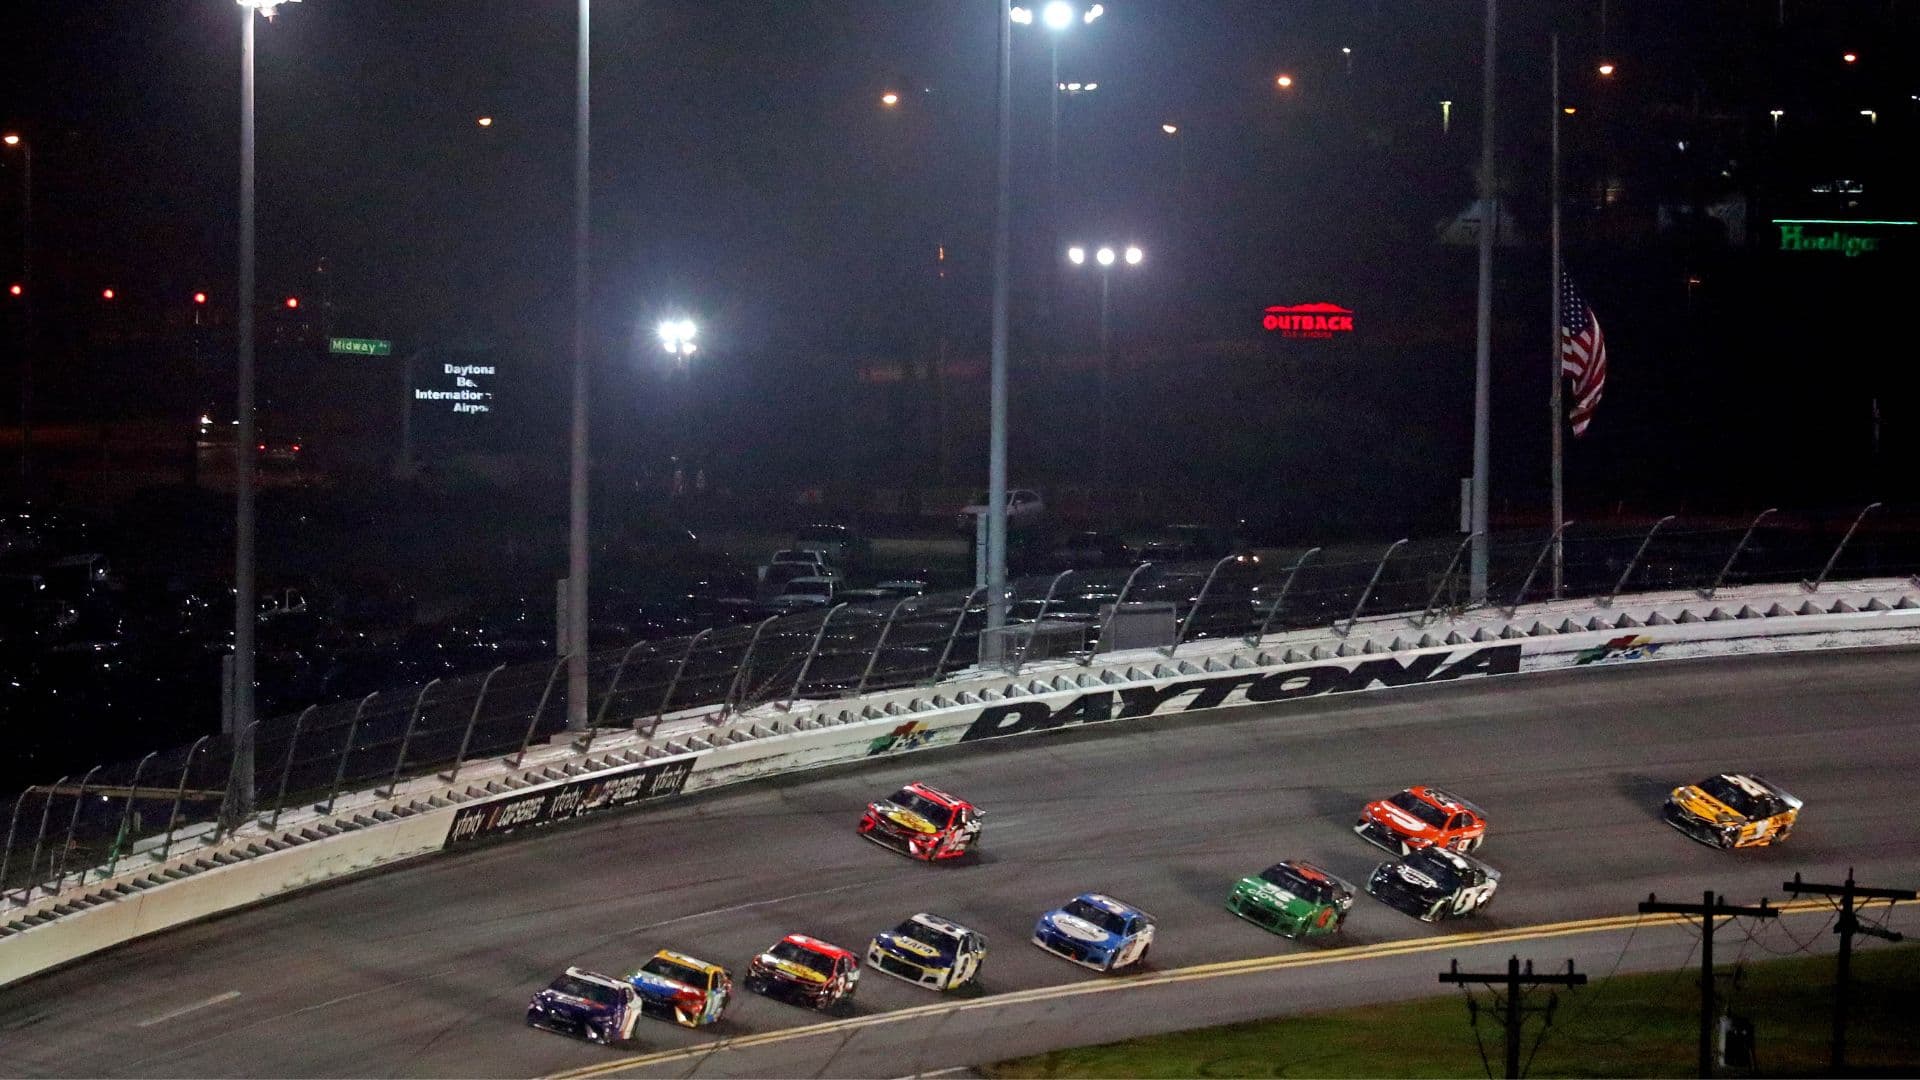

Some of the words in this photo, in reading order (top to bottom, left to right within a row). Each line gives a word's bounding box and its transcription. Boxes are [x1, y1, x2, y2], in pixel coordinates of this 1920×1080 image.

[1263, 315, 1353, 331] OUTBACK
[332, 340, 376, 354] Midway
[444, 363, 496, 376] Daytona
[959, 644, 1522, 742] DAYTONA
[452, 808, 486, 841] xfinity
[549, 786, 583, 820] xfinity
[649, 765, 688, 797] xfinity
